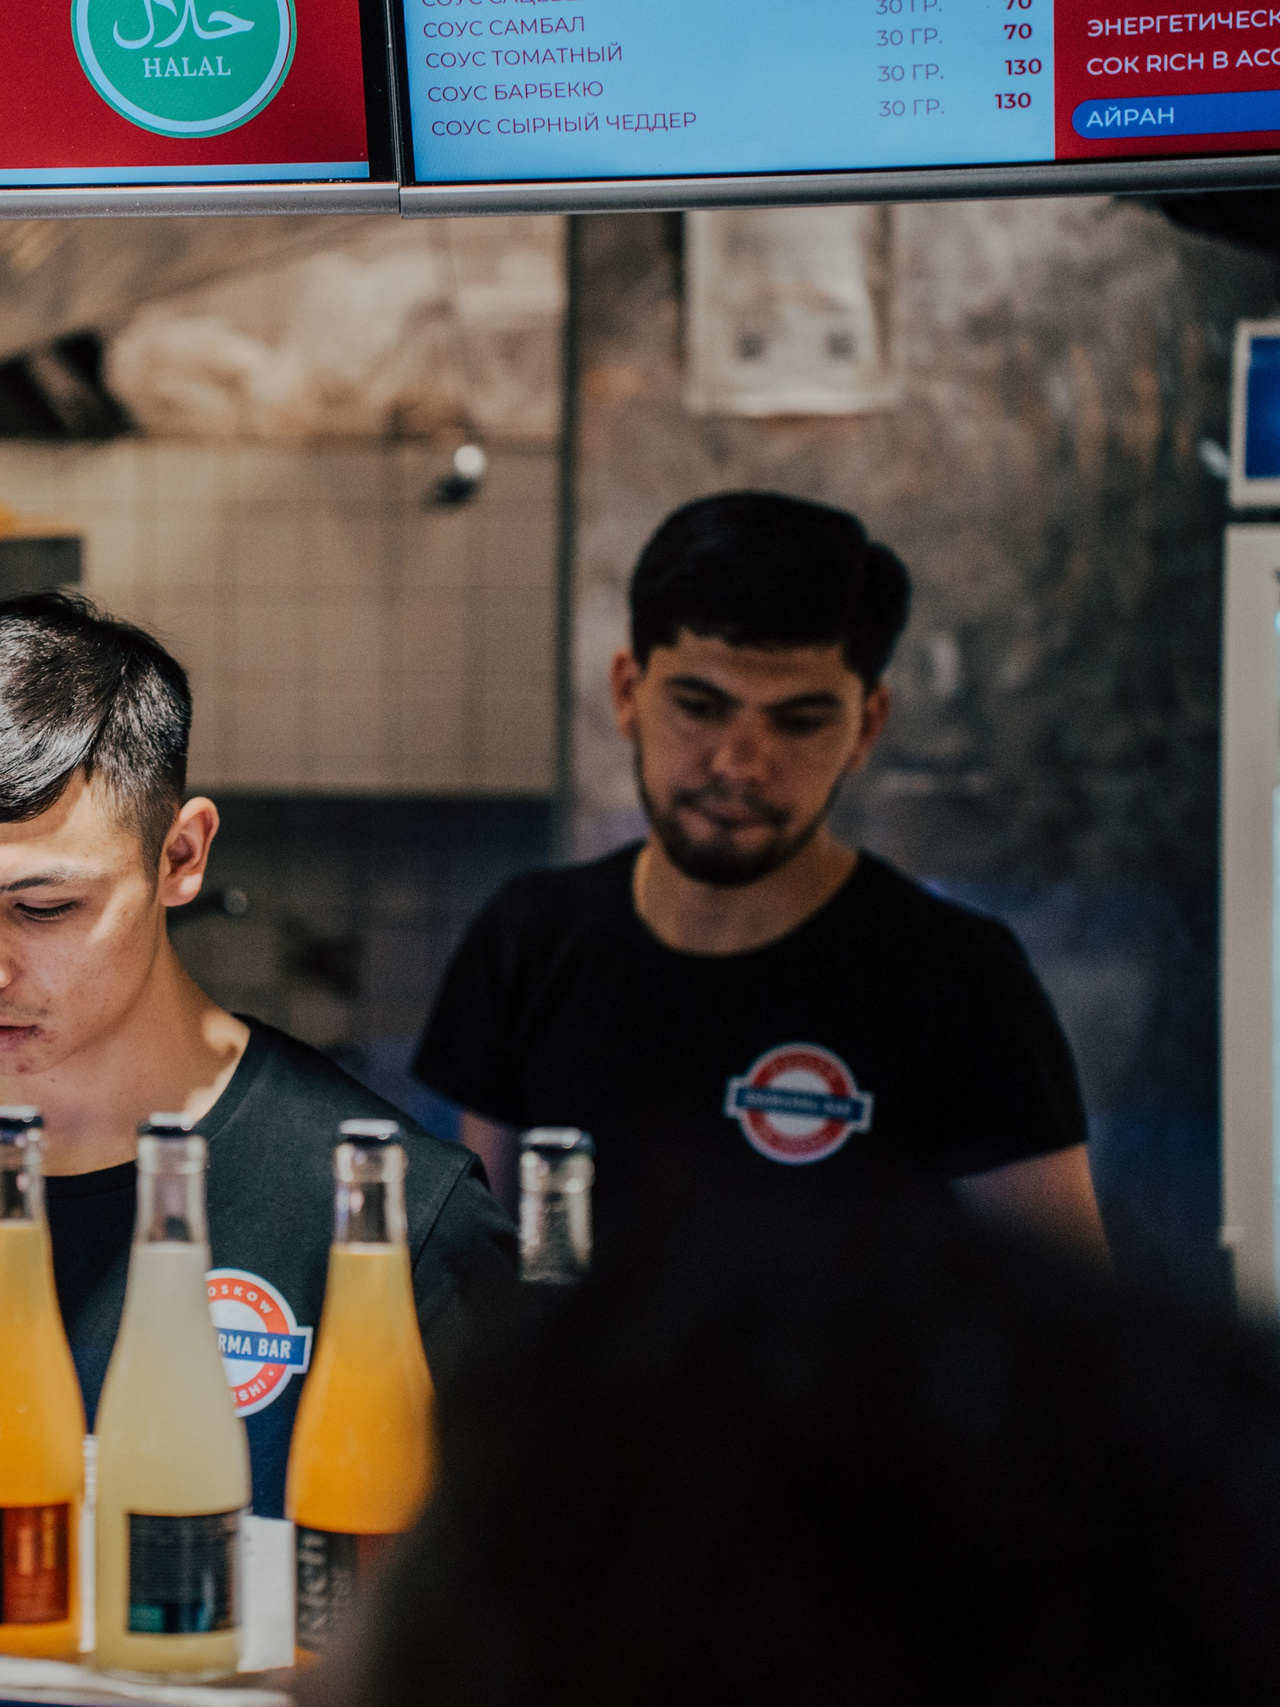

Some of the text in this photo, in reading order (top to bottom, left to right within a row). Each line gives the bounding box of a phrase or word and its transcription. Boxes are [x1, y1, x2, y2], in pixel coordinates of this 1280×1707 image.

[875, 0, 903, 15] 30
[422, 16, 585, 39] СОУС САМБАЛ
[876, 27, 943, 47] 30 ГР.
[1003, 23, 1033, 40] 70
[143, 55, 232, 78] HALAL
[425, 42, 623, 69] СОУС ТОМАТНЫЙ
[1086, 55, 1140, 76] СОК
[1146, 52, 1205, 73] RICH
[878, 63, 944, 82] 30 ГР.
[1005, 58, 1043, 76] 130
[427, 80, 604, 103] СОУС БАРБЕКЮ
[994, 92, 1032, 110] 130
[879, 98, 945, 118] 30 ГР.
[1086, 106, 1175, 128] АЙРАН
[431, 111, 698, 137] СОУС СЫРНЫЙ ЧЕДДЕР
[206, 1283, 273, 1314] OSKOW
[217, 1333, 292, 1360] RMA BAR
